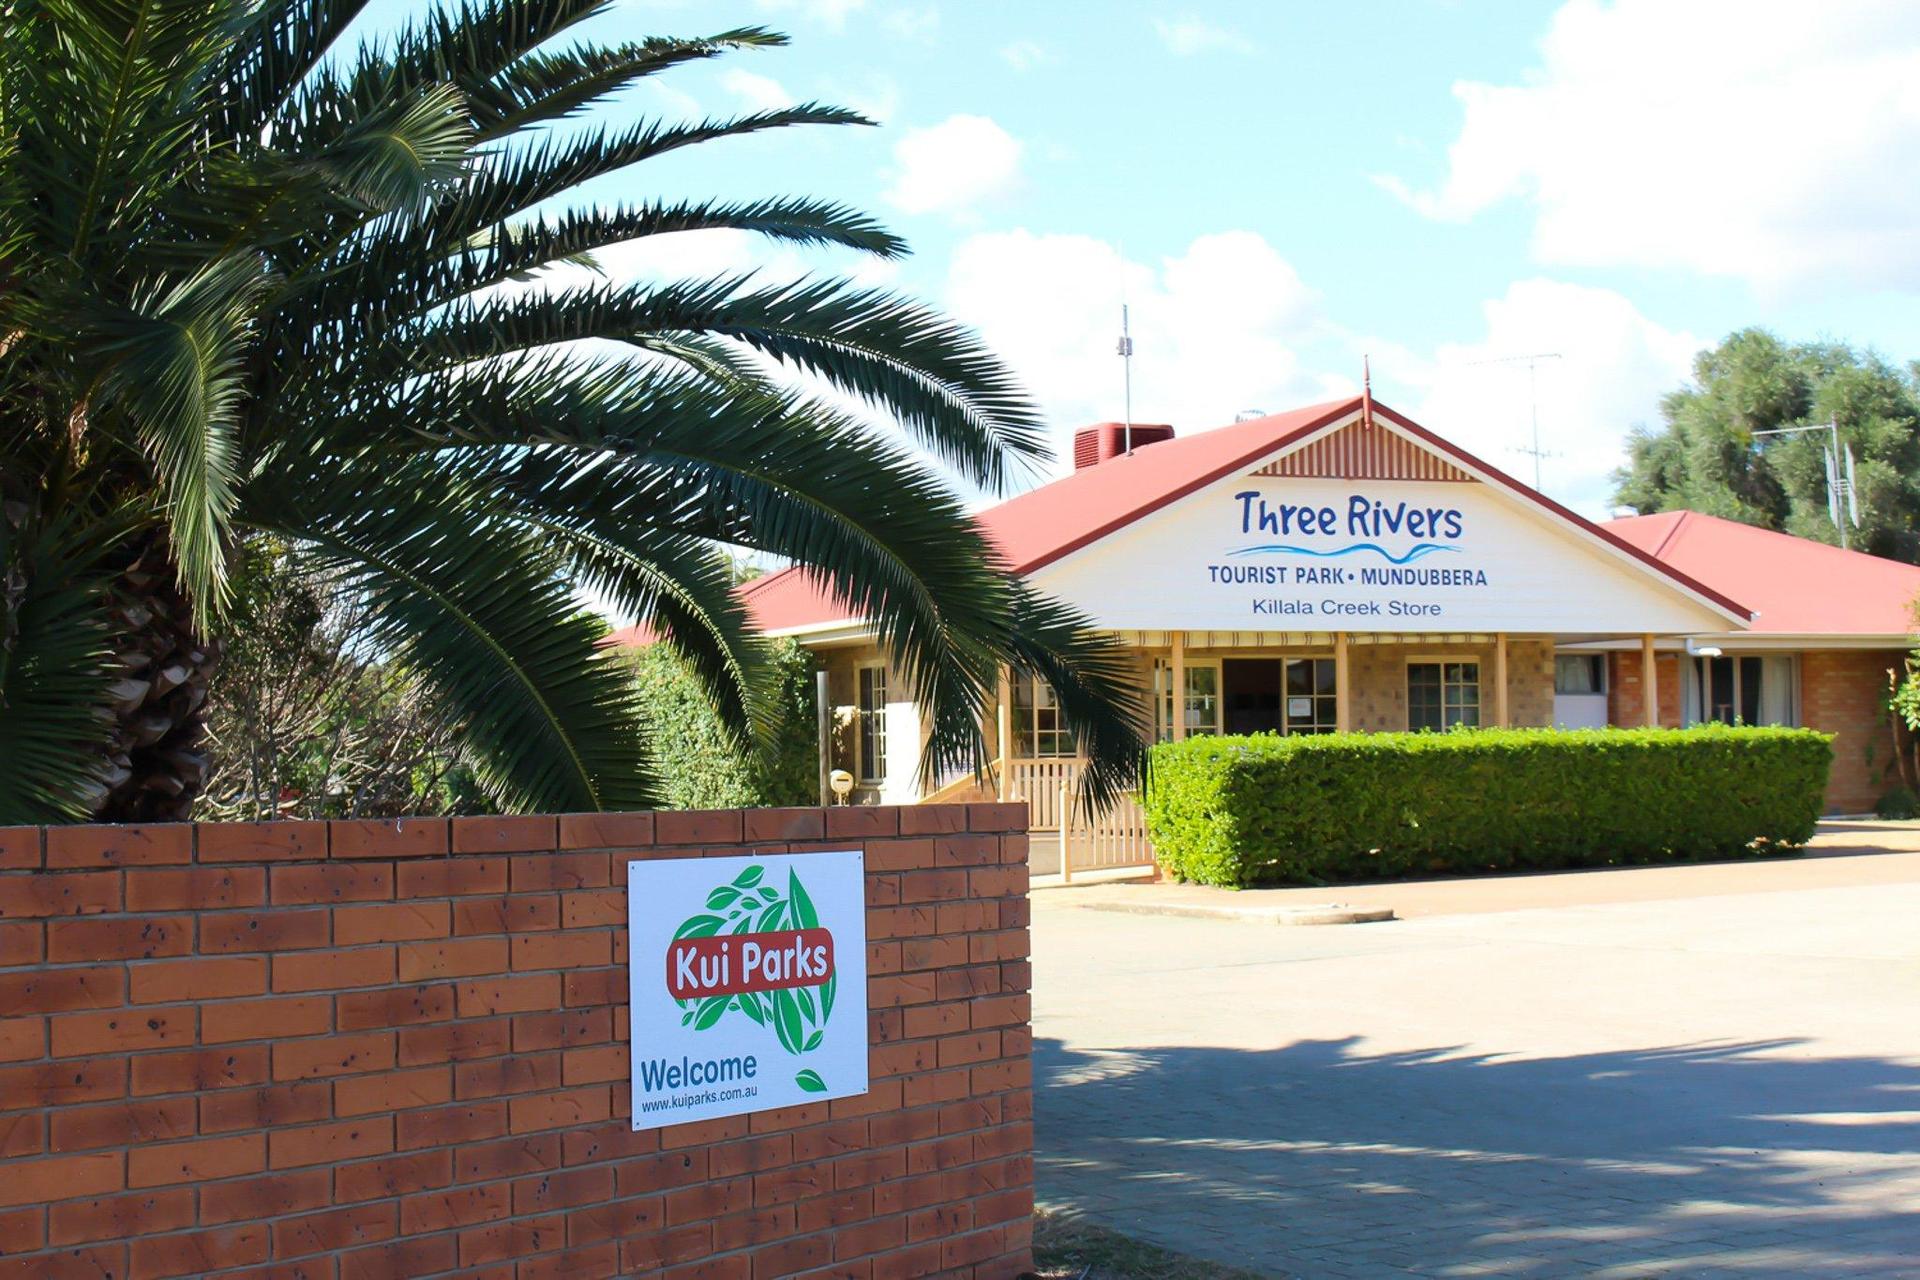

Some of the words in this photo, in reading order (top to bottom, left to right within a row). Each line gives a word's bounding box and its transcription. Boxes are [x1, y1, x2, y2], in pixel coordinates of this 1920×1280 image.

[1234, 491, 1337, 536] Three
[1347, 494, 1463, 539] Rivers
[1208, 565, 1287, 584] TOURIST
[1296, 567, 1344, 584] PARK
[1361, 568, 1488, 586] MUNDUBBERA
[1253, 599, 1313, 615] Killala
[1321, 599, 1382, 616] Creek
[1388, 600, 1441, 616] Store
[676, 941, 730, 991] Kui
[742, 934, 828, 985] Parks
[641, 1055, 758, 1092] Welcome
[642, 1085, 758, 1113] www.kuiparks.com.au
